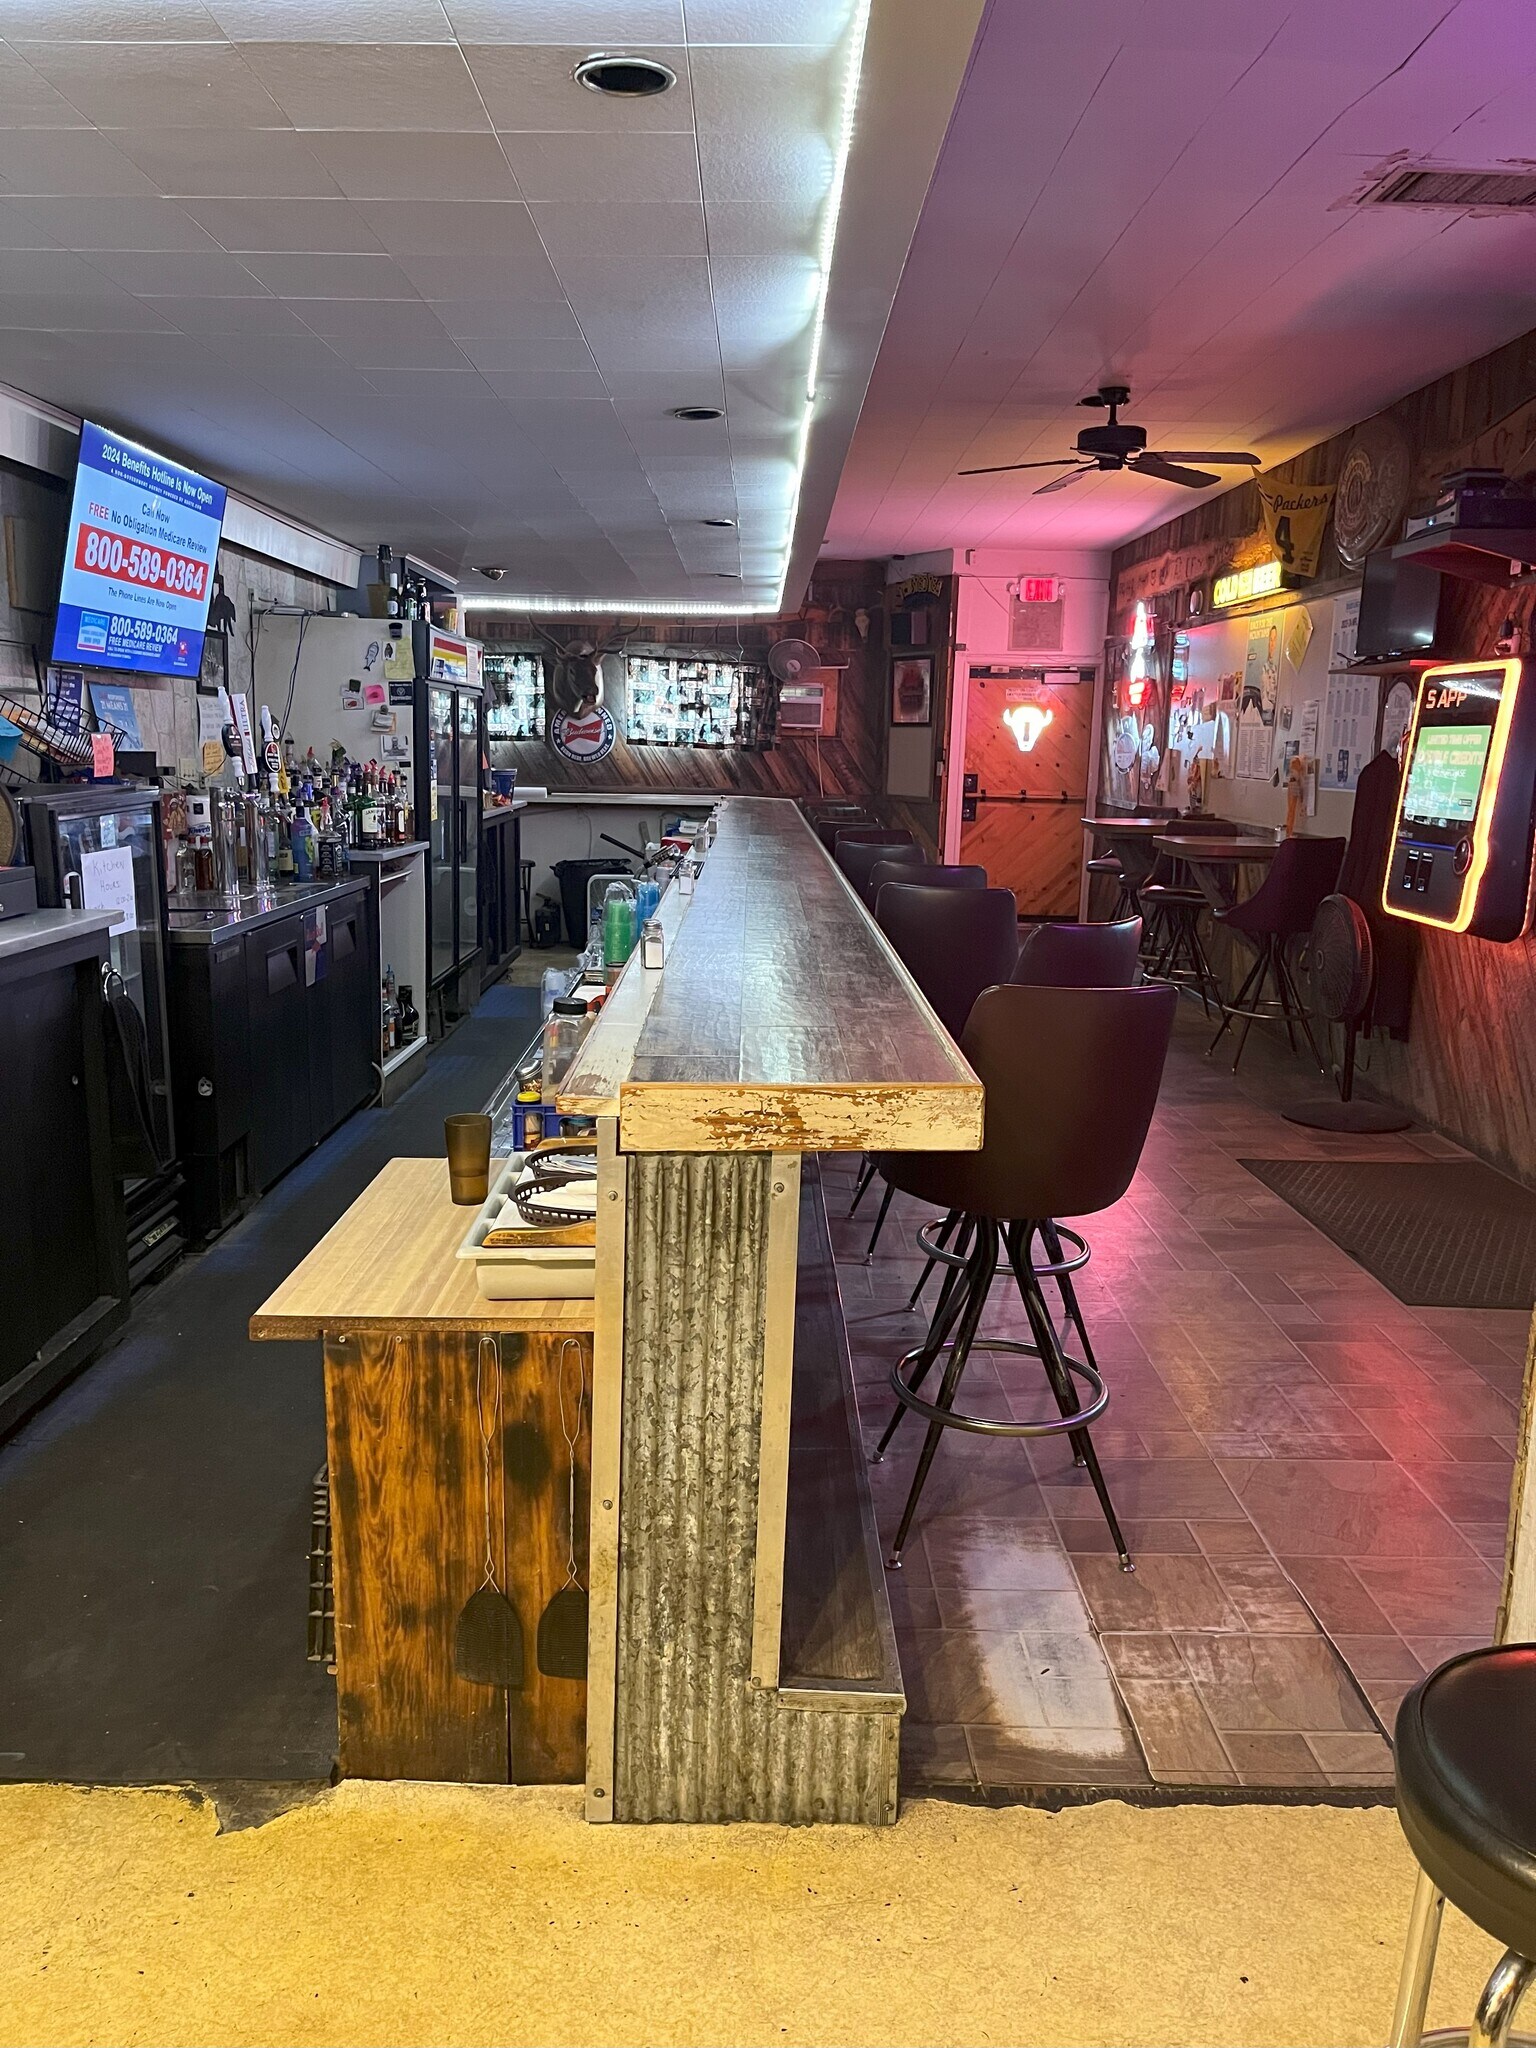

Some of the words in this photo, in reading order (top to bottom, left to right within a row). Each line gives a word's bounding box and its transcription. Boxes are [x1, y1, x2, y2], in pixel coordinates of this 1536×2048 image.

[102, 444, 121, 464] 2024
[122, 453, 151, 478] Benefits
[152, 466, 175, 488] Hotline
[176, 477, 182, 491] Is
[182, 480, 196, 497] Now
[197, 487, 213, 505] Open
[142, 503, 155, 518] Call
[156, 510, 170, 524] Now
[1273, 492, 1329, 513] Packers
[88, 502, 109, 520] FREE
[111, 510, 122, 525] No
[123, 514, 157, 538] Obligation
[158, 526, 186, 548] Medicare
[187, 537, 207, 554] Review
[1275, 516, 1294, 564] 4
[85, 532, 204, 595] 800-589-0364
[108, 587, 117, 597] The
[118, 589, 133, 601] Phone
[134, 593, 146, 603] Lines
[147, 596, 155, 605] Are
[156, 598, 165, 607] Now
[166, 601, 177, 610] Open
[1025, 579, 1053, 601] EXIT
[110, 616, 178, 645] 800-589-0364
[108, 636, 121, 646] FREE
[122, 639, 146, 650] MEDICARE
[146, 642, 163, 652] REVIEW
[240, 700, 250, 731] ULTRA
[92, 859, 125, 877] Kitchen
[101, 881, 120, 892] Hours
